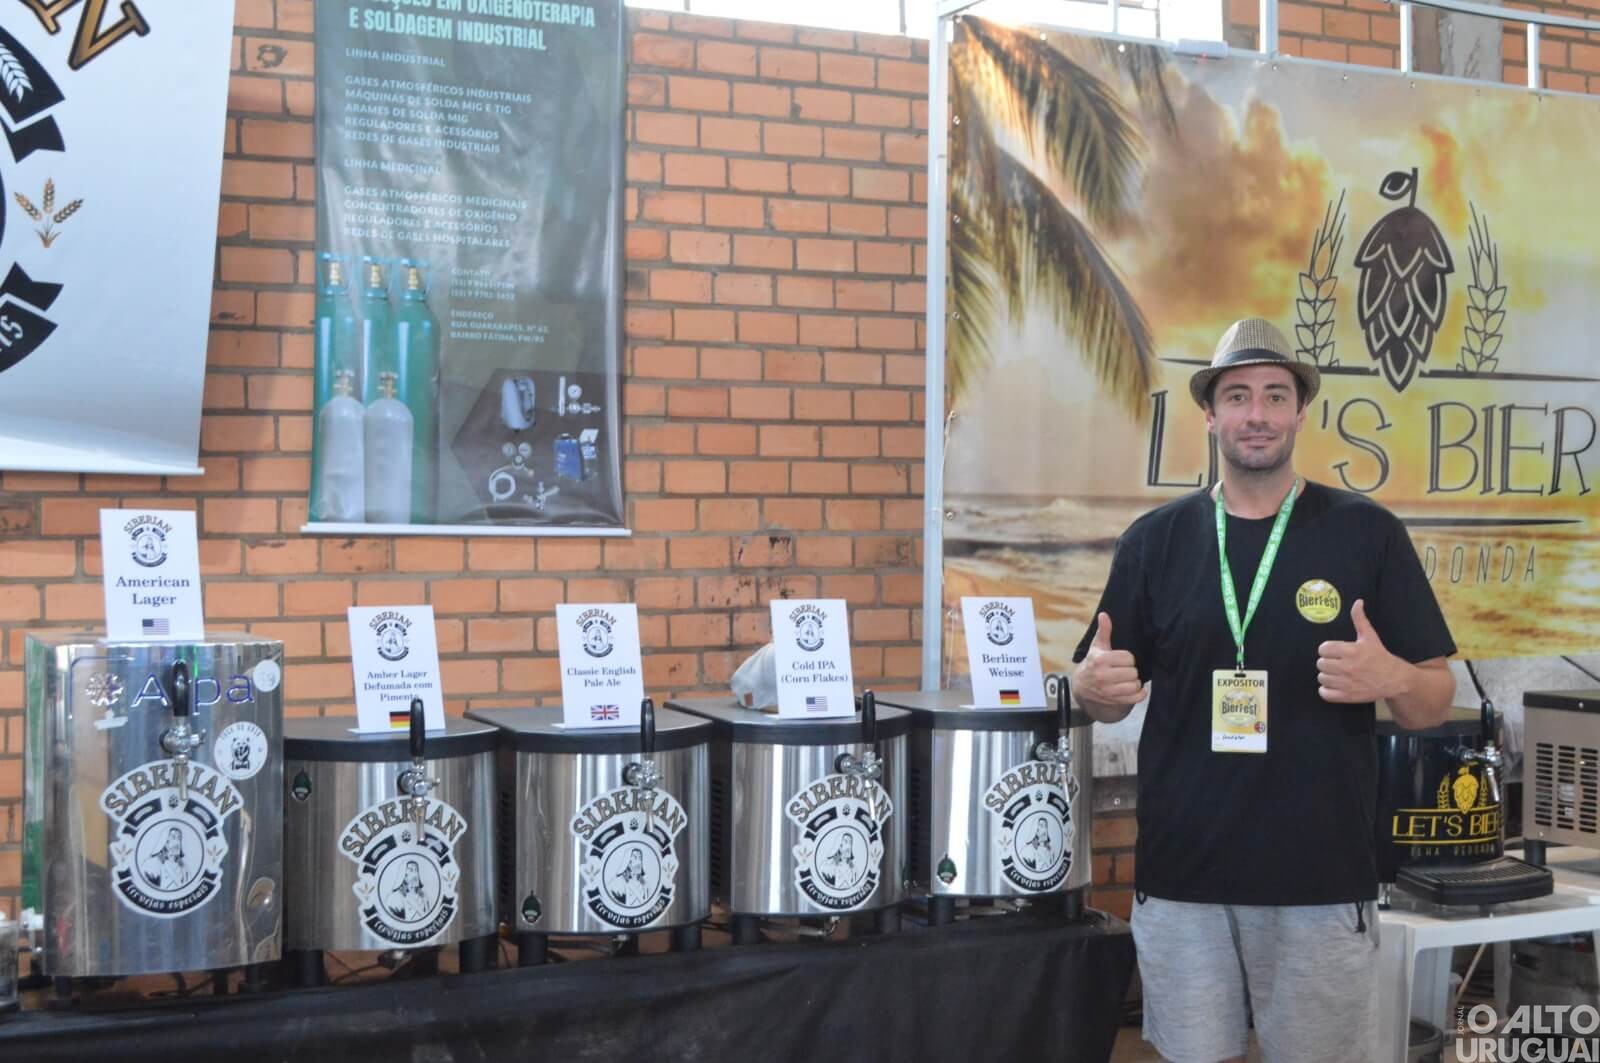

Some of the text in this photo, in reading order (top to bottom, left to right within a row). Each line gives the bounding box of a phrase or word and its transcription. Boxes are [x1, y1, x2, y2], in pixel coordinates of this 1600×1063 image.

[466, 0, 595, 27] OXIGENOTERAPIA
[349, 7, 546, 50] E SOLDAGEM INDUSTRIAL
[346, 48, 446, 67] LINHA INDUSTRIAL
[345, 75, 533, 104] GASES ATMOSFÉRICOS INDUSTRIAIS
[345, 88, 512, 115] MÁQUINAS DE SOLDA MIG E TIG
[344, 103, 469, 123] ARAMES DE SOLDA MIG
[345, 117, 500, 140] REGULADORES E ACESSÓRIOS
[345, 130, 500, 153] REDES DE GASES INDUSTRIAIS
[344, 159, 441, 176] LINHA MEDICINAL
[344, 185, 528, 209] GASES ATMOSFÉRICOS MEDICINAIS
[344, 199, 517, 222] CONCENTRADORES DE OXIGÊNIO
[344, 214, 498, 234] REGULADORES E ACESSÓRIOS
[344, 227, 511, 248] REDES DE GASES HOSPITALARES
[1147, 390, 1597, 497] L'S BIER
[123, 514, 172, 534] SIBERIAN
[1424, 545, 1537, 584] DONDA
[116, 575, 190, 588] American
[132, 593, 177, 608] Lager
[792, 660, 836, 671] Cold IPA
[982, 653, 1028, 664] Berliner
[367, 669, 428, 680] Amber Lager
[567, 666, 636, 677] Classic English
[781, 673, 848, 684] (Corn Flakes)
[989, 667, 1025, 678] Weisse
[364, 681, 433, 691] Defumada com
[584, 678, 621, 688] Pale Ale
[1217, 679, 1265, 688] EXPOSITOR
[380, 693, 419, 702] Pimenta
[104, 762, 240, 817] SIBERIAN
[1392, 814, 1463, 837] LET'S
